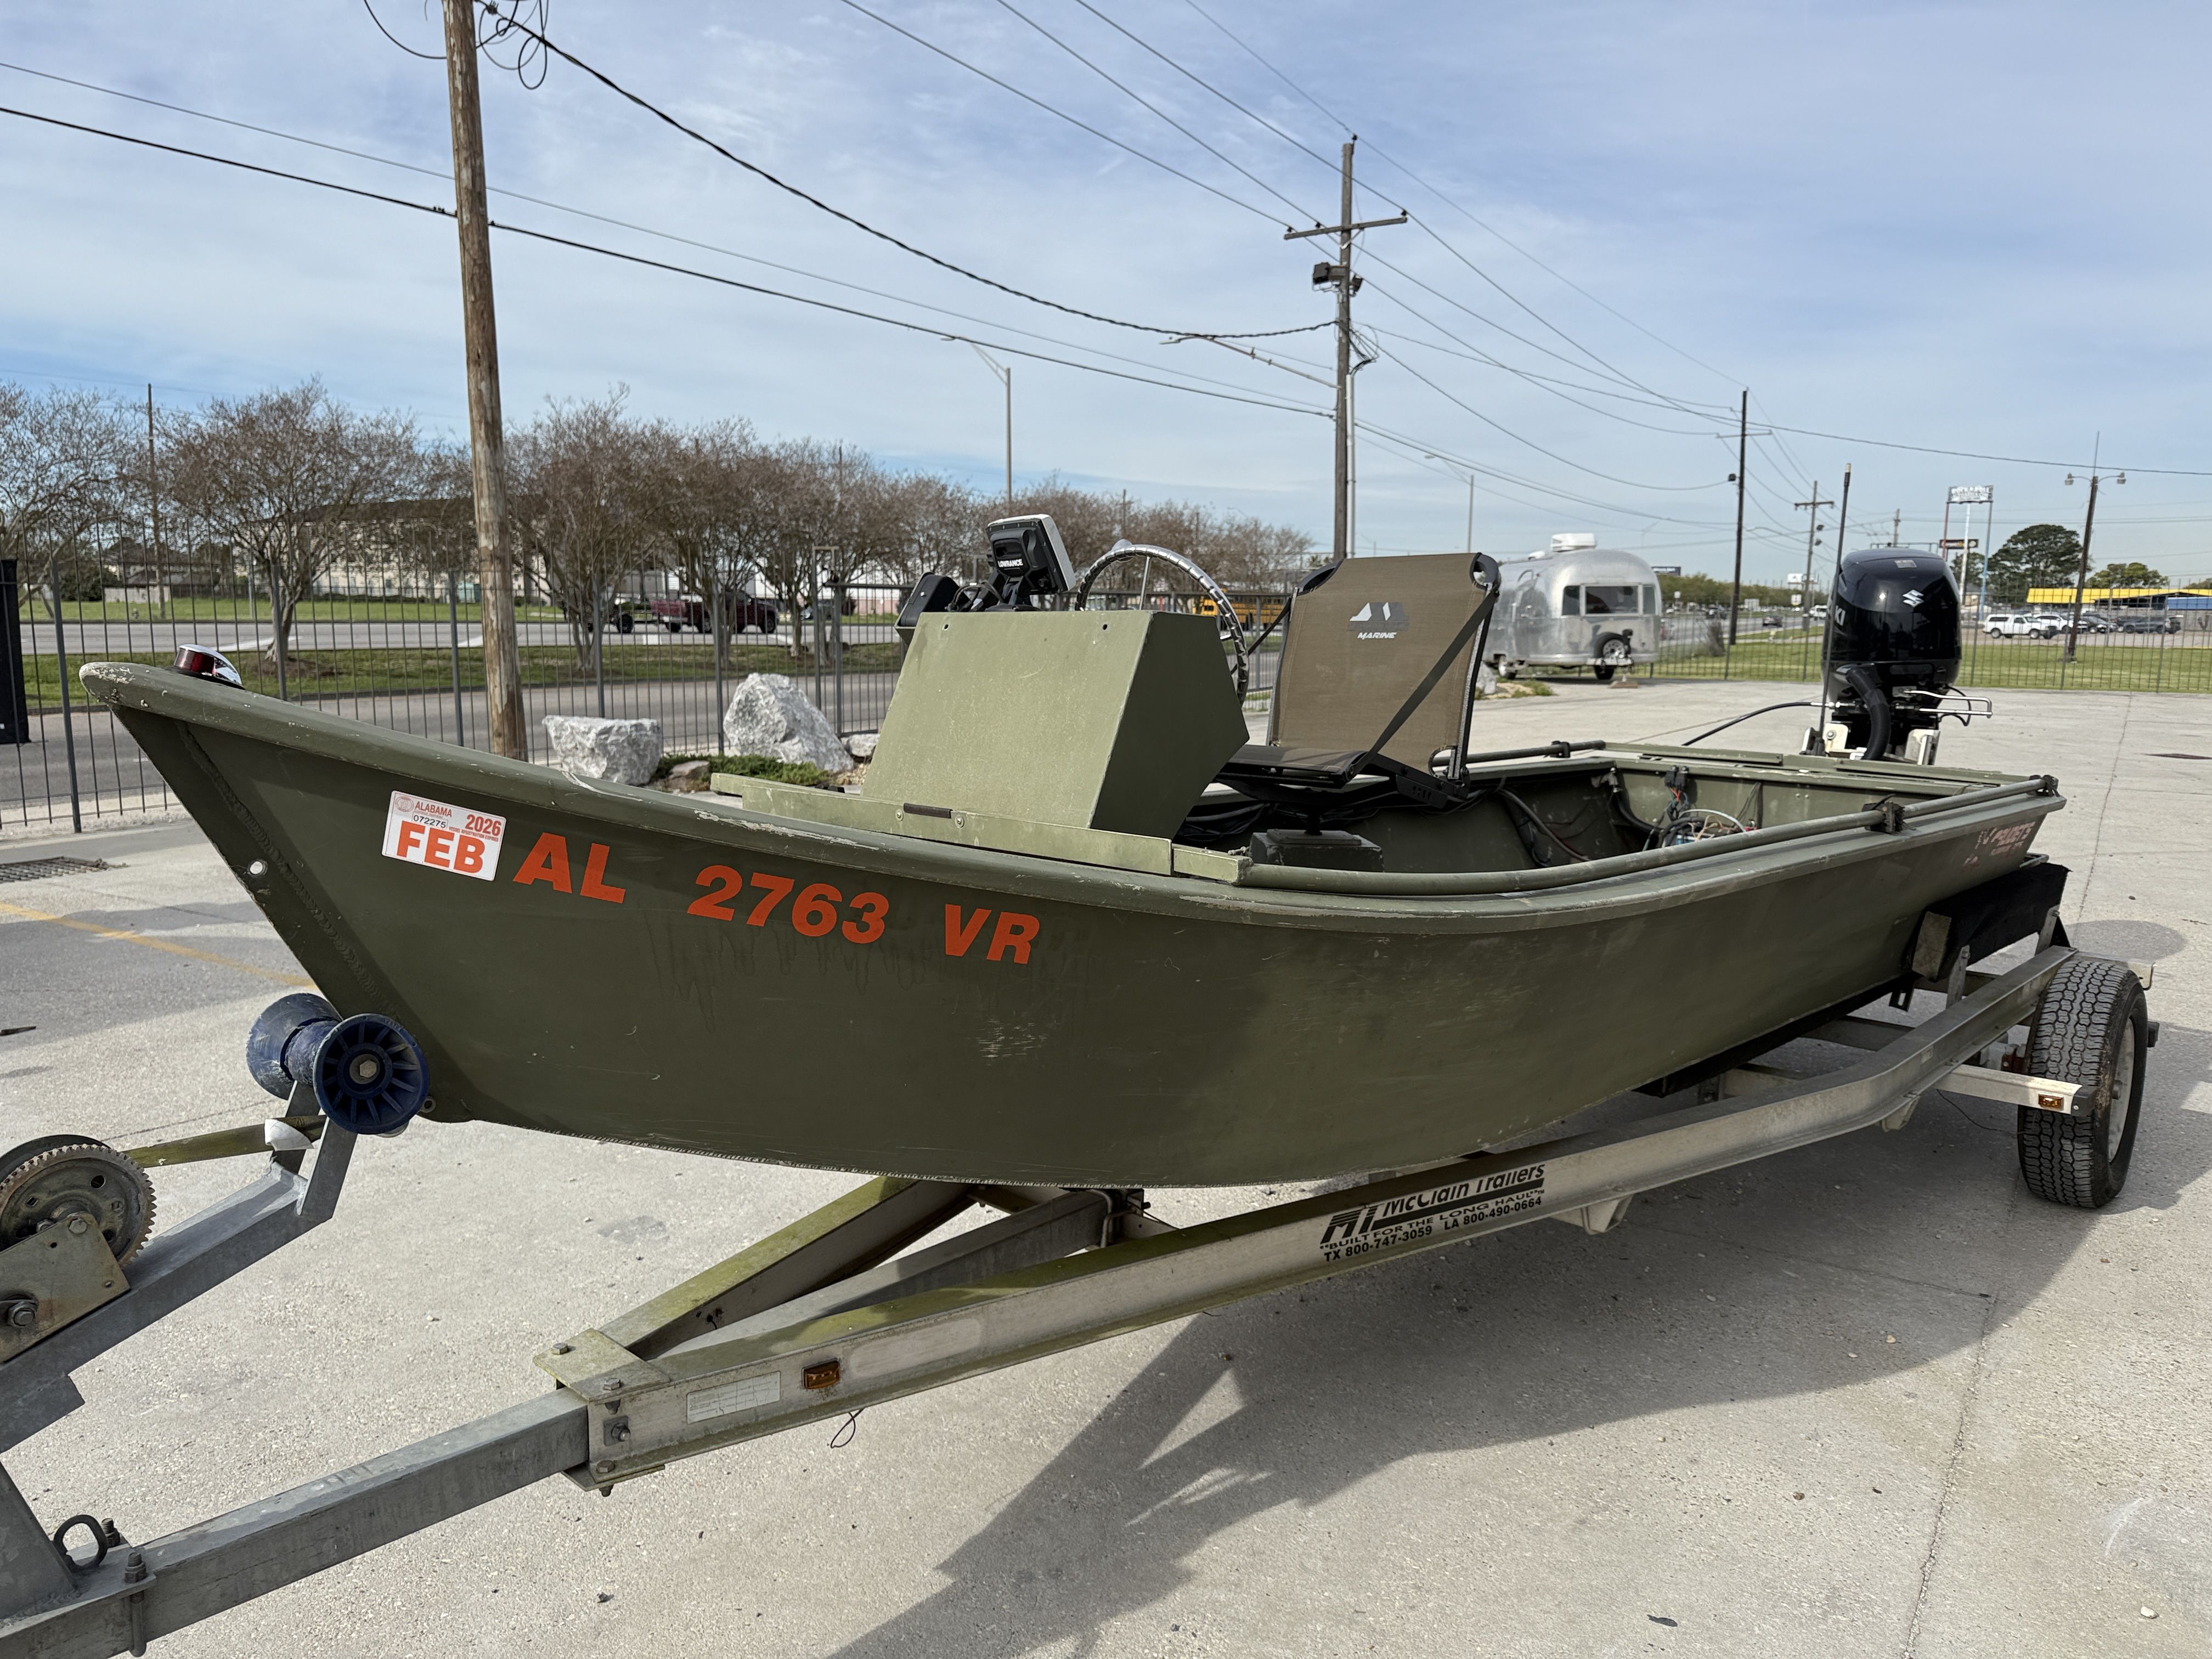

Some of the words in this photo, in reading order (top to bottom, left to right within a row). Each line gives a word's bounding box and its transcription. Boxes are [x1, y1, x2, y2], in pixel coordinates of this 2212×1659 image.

[997, 558, 1024, 568] LOWRANCE
[413, 815, 446, 828] 072275
[415, 801, 452, 817] ALABAMA
[465, 814, 502, 836] 2026
[396, 820, 485, 873] FEB
[512, 832, 626, 904] AL
[687, 865, 889, 944] 2763
[945, 904, 1040, 964] VR
[1373, 1226, 1403, 1238] FOR
[1407, 1217, 1434, 1228] THE
[1440, 1203, 1489, 1220] LONG
[1324, 1249, 1341, 1262] TX
[1444, 1220, 1459, 1230] LA
